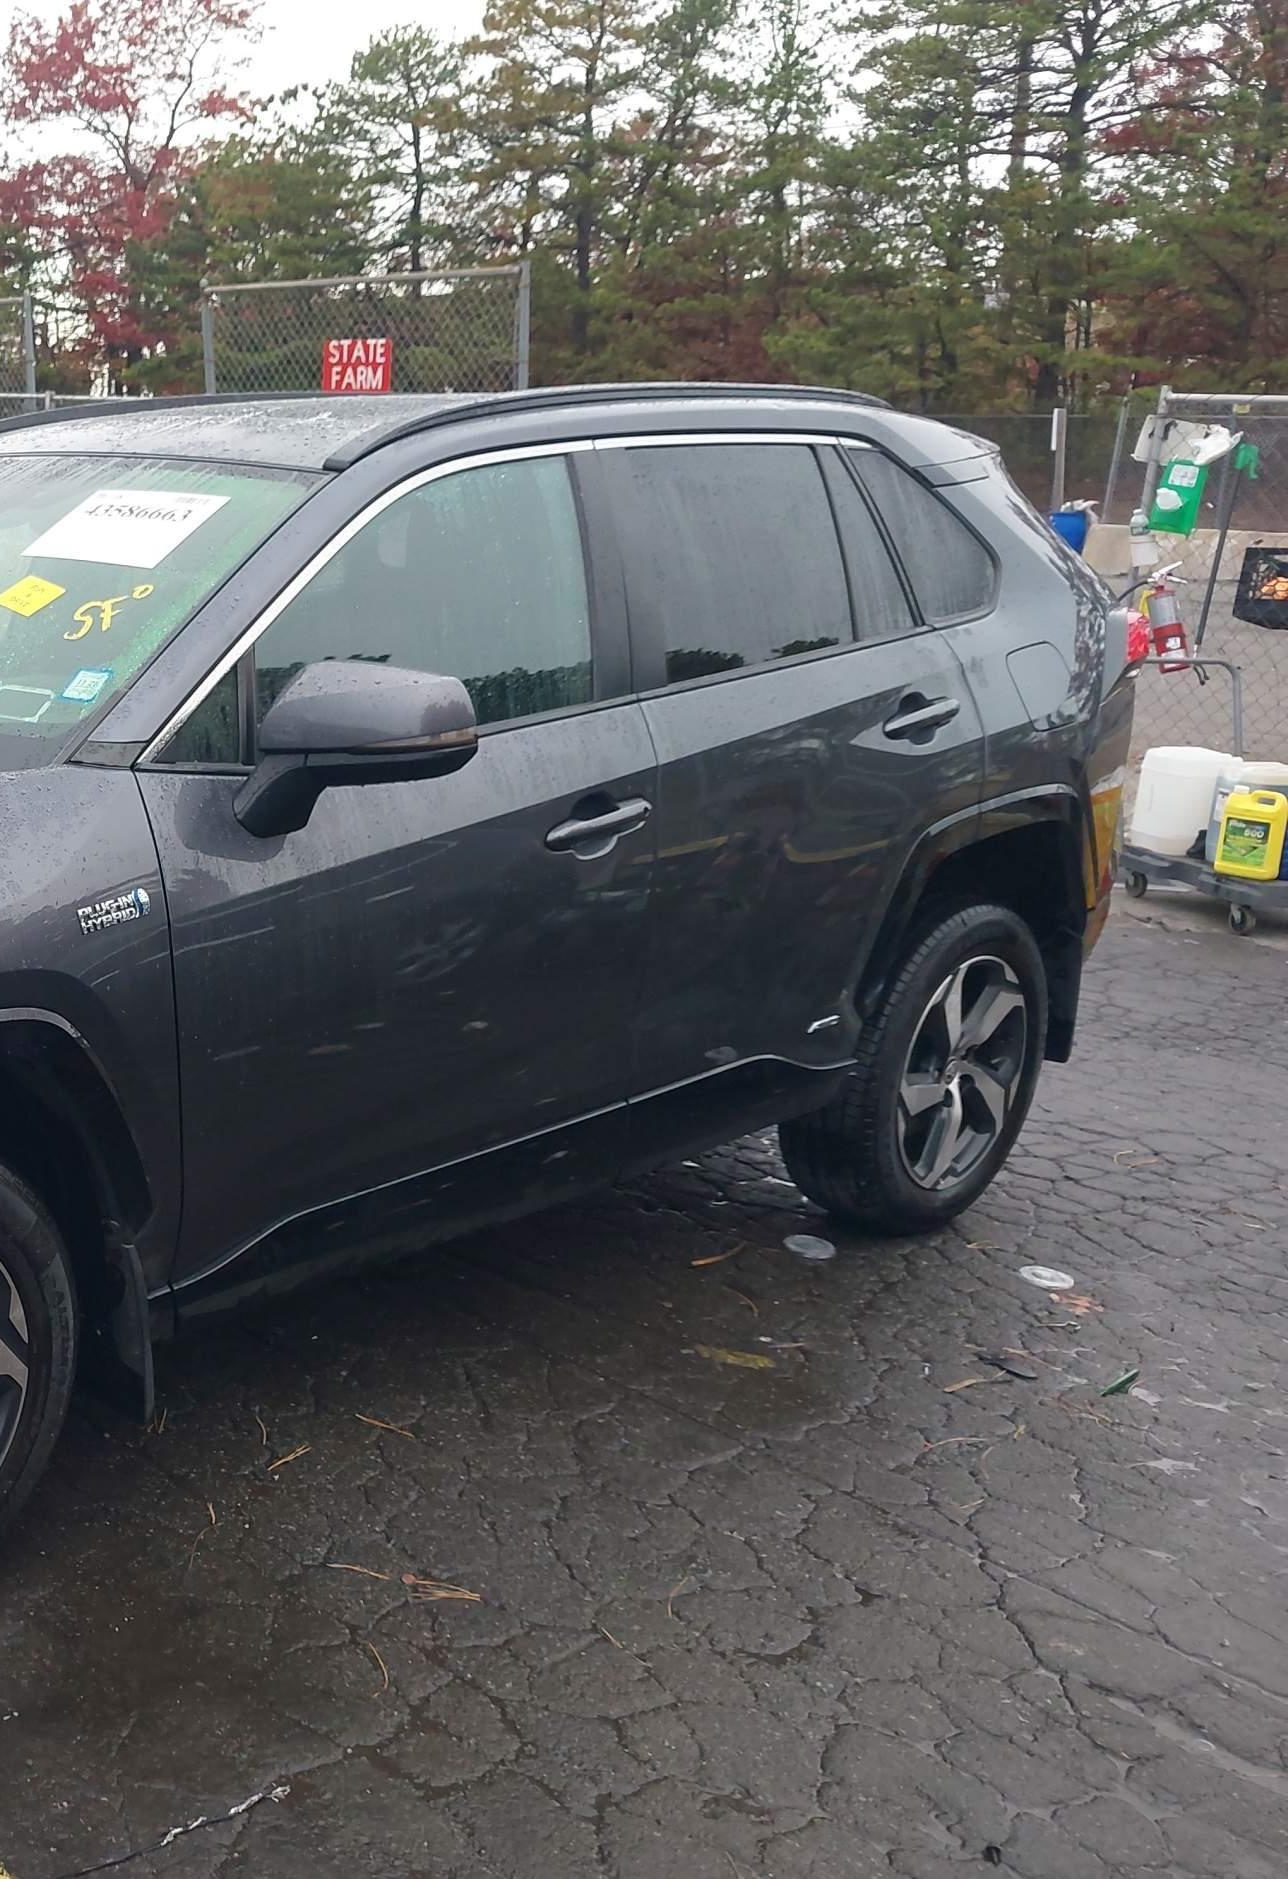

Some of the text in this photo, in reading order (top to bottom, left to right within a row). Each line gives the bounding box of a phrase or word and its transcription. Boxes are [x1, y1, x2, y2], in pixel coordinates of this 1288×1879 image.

[328, 338, 386, 364] STATE
[331, 365, 383, 390] FARM
[78, 894, 133, 918] PLUG-IN
[81, 908, 136, 934] HYBRID
